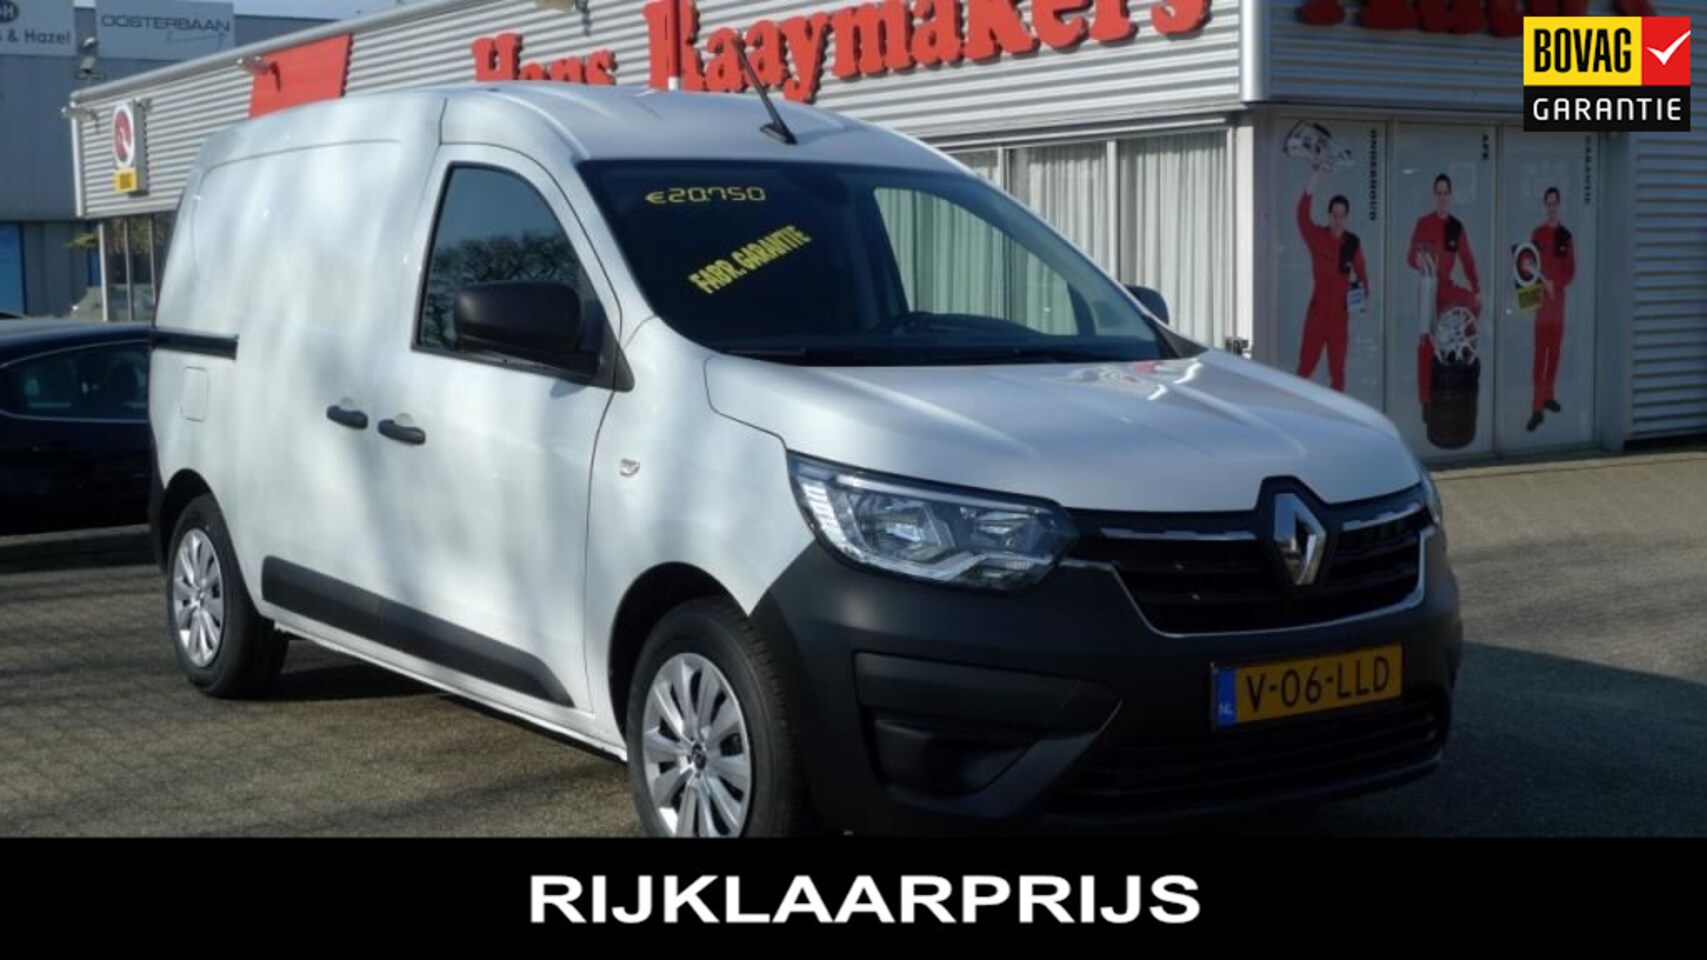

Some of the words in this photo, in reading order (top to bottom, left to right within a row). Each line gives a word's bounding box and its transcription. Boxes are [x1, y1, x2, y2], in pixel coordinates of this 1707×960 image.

[101, 14, 230, 32] OOSTERBAAN
[24, 29, 71, 44] Hazel
[1246, 655, 1390, 713] V-06-LLD
[1218, 702, 1235, 715] NL
